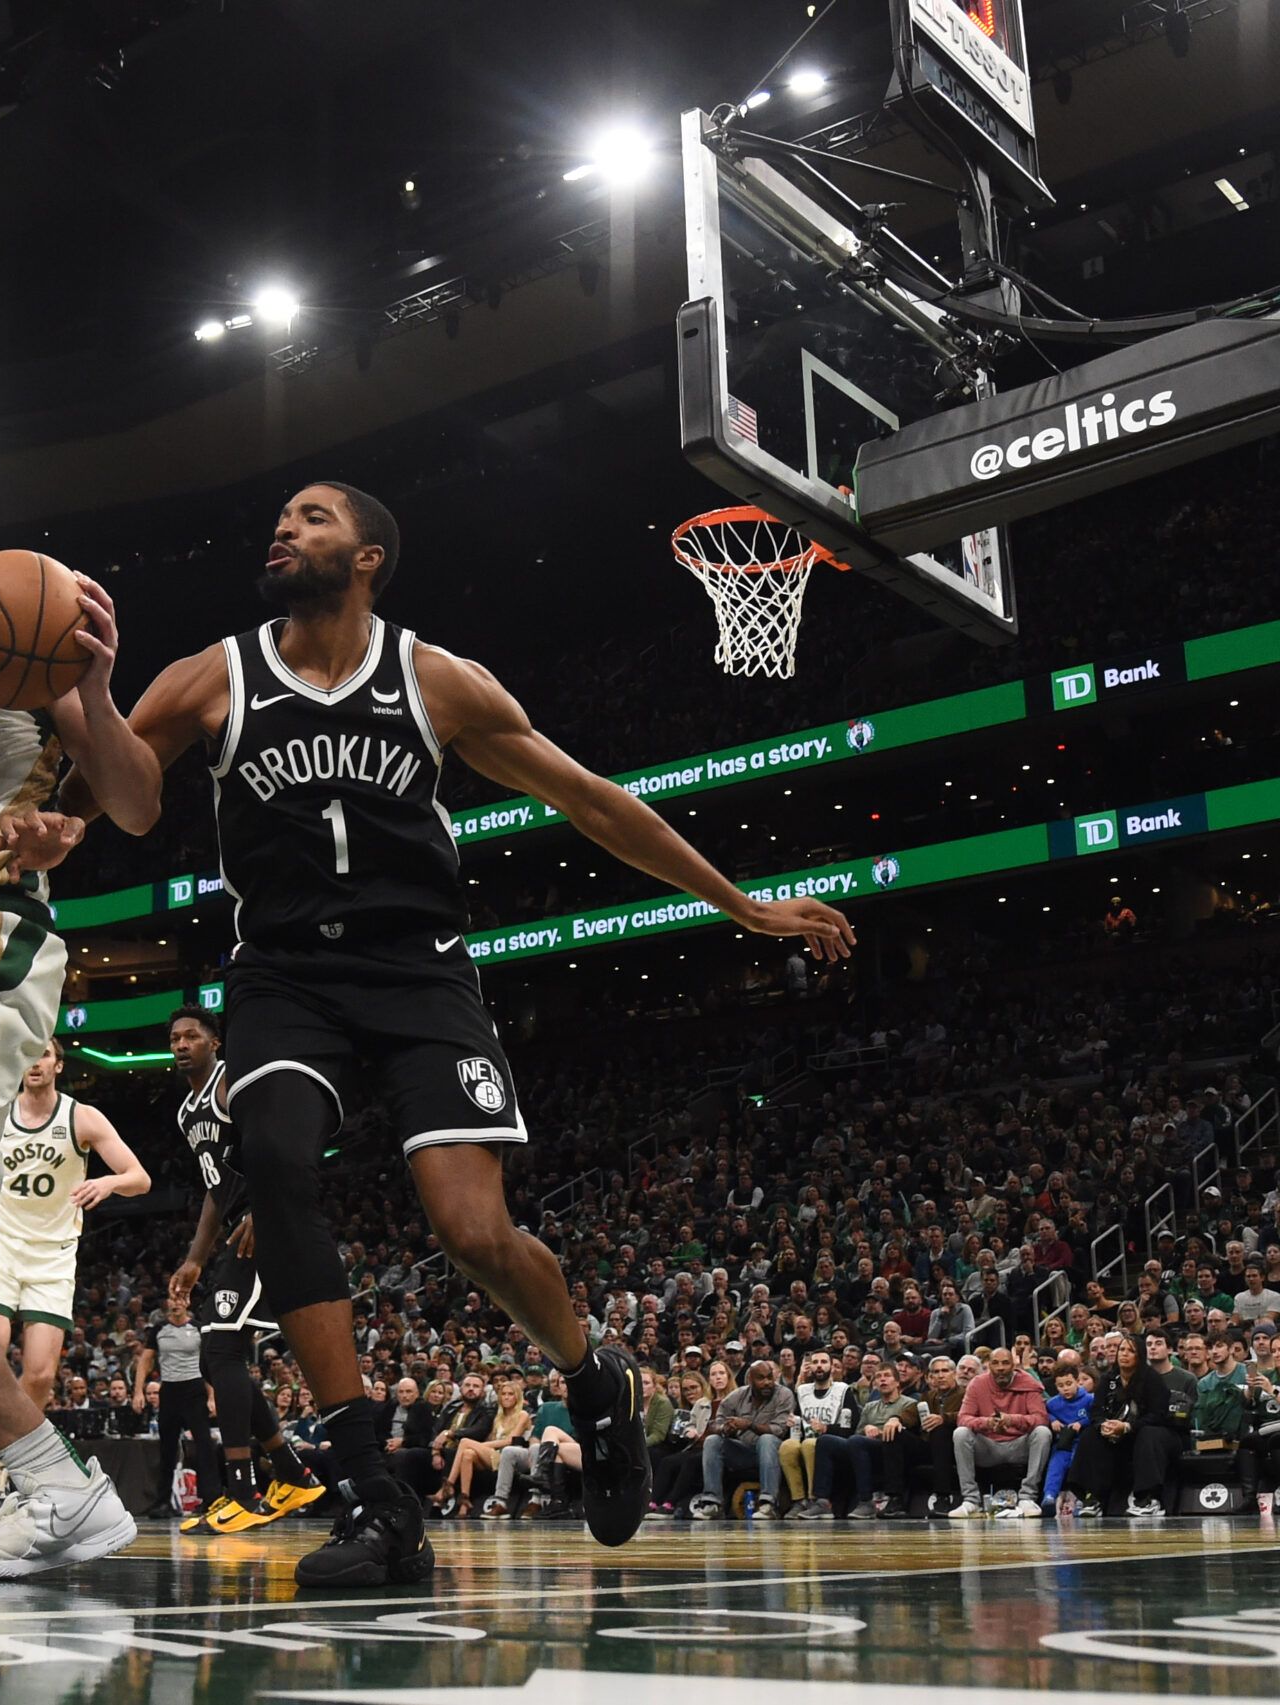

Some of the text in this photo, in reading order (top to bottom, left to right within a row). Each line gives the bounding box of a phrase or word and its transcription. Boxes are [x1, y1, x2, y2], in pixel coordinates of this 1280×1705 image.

[946, 11, 1024, 105] TISSOT
[970, 390, 1177, 480] @celtics
[1056, 660, 1161, 701] TD Bank
[372, 705, 403, 717] Webull
[238, 734, 421, 802] BROOKLYN
[707, 757, 748, 780] has
[751, 754, 765, 769] a
[768, 736, 833, 766] story.
[321, 799, 350, 874] 1
[465, 818, 478, 835] a
[480, 804, 534, 834] story.
[1079, 808, 1183, 847] TD Bank
[171, 878, 224, 902] TD Ban
[468, 938, 491, 960] as
[494, 938, 506, 954] a
[509, 926, 562, 953] story.
[573, 914, 627, 940] Every
[632, 900, 721, 929] custome
[777, 884, 792, 900] a
[794, 870, 858, 897] story.
[201, 988, 222, 1009] TD
[3, 1142, 66, 1172] BOSTON
[9, 1172, 56, 1198] 40
[215, 1290, 239, 1304] NETS
